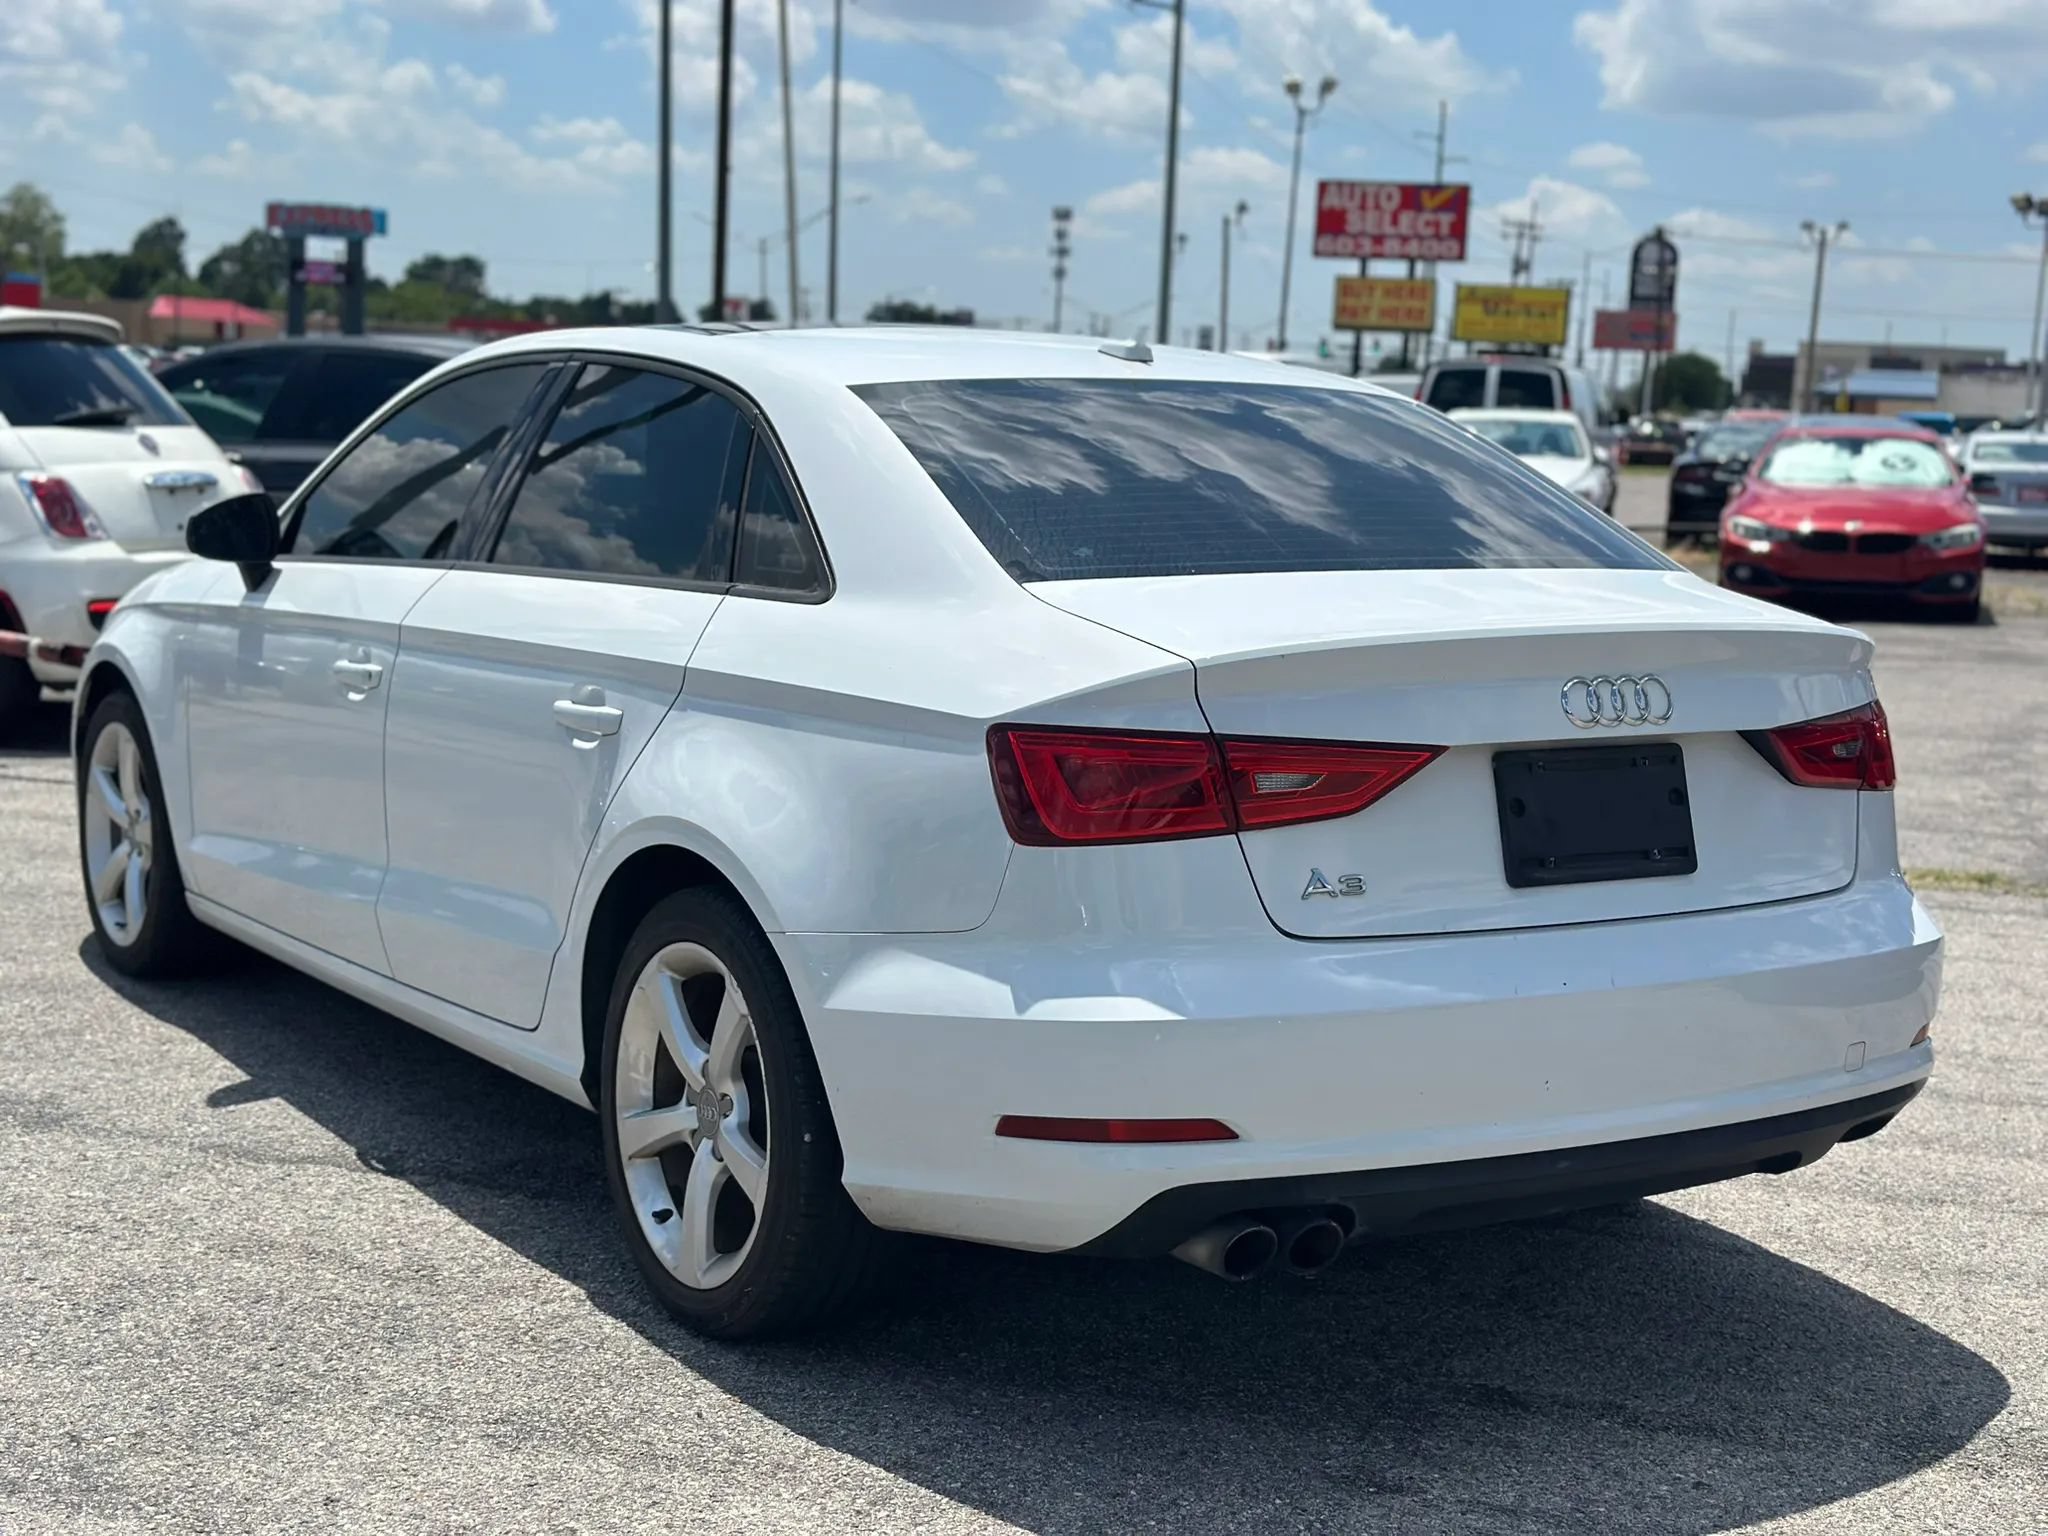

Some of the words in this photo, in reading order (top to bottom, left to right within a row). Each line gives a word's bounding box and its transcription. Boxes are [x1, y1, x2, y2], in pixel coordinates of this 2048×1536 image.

[1321, 184, 1400, 211] AUTO
[1344, 209, 1456, 236] SELECT
[1301, 867, 1367, 900] A3
